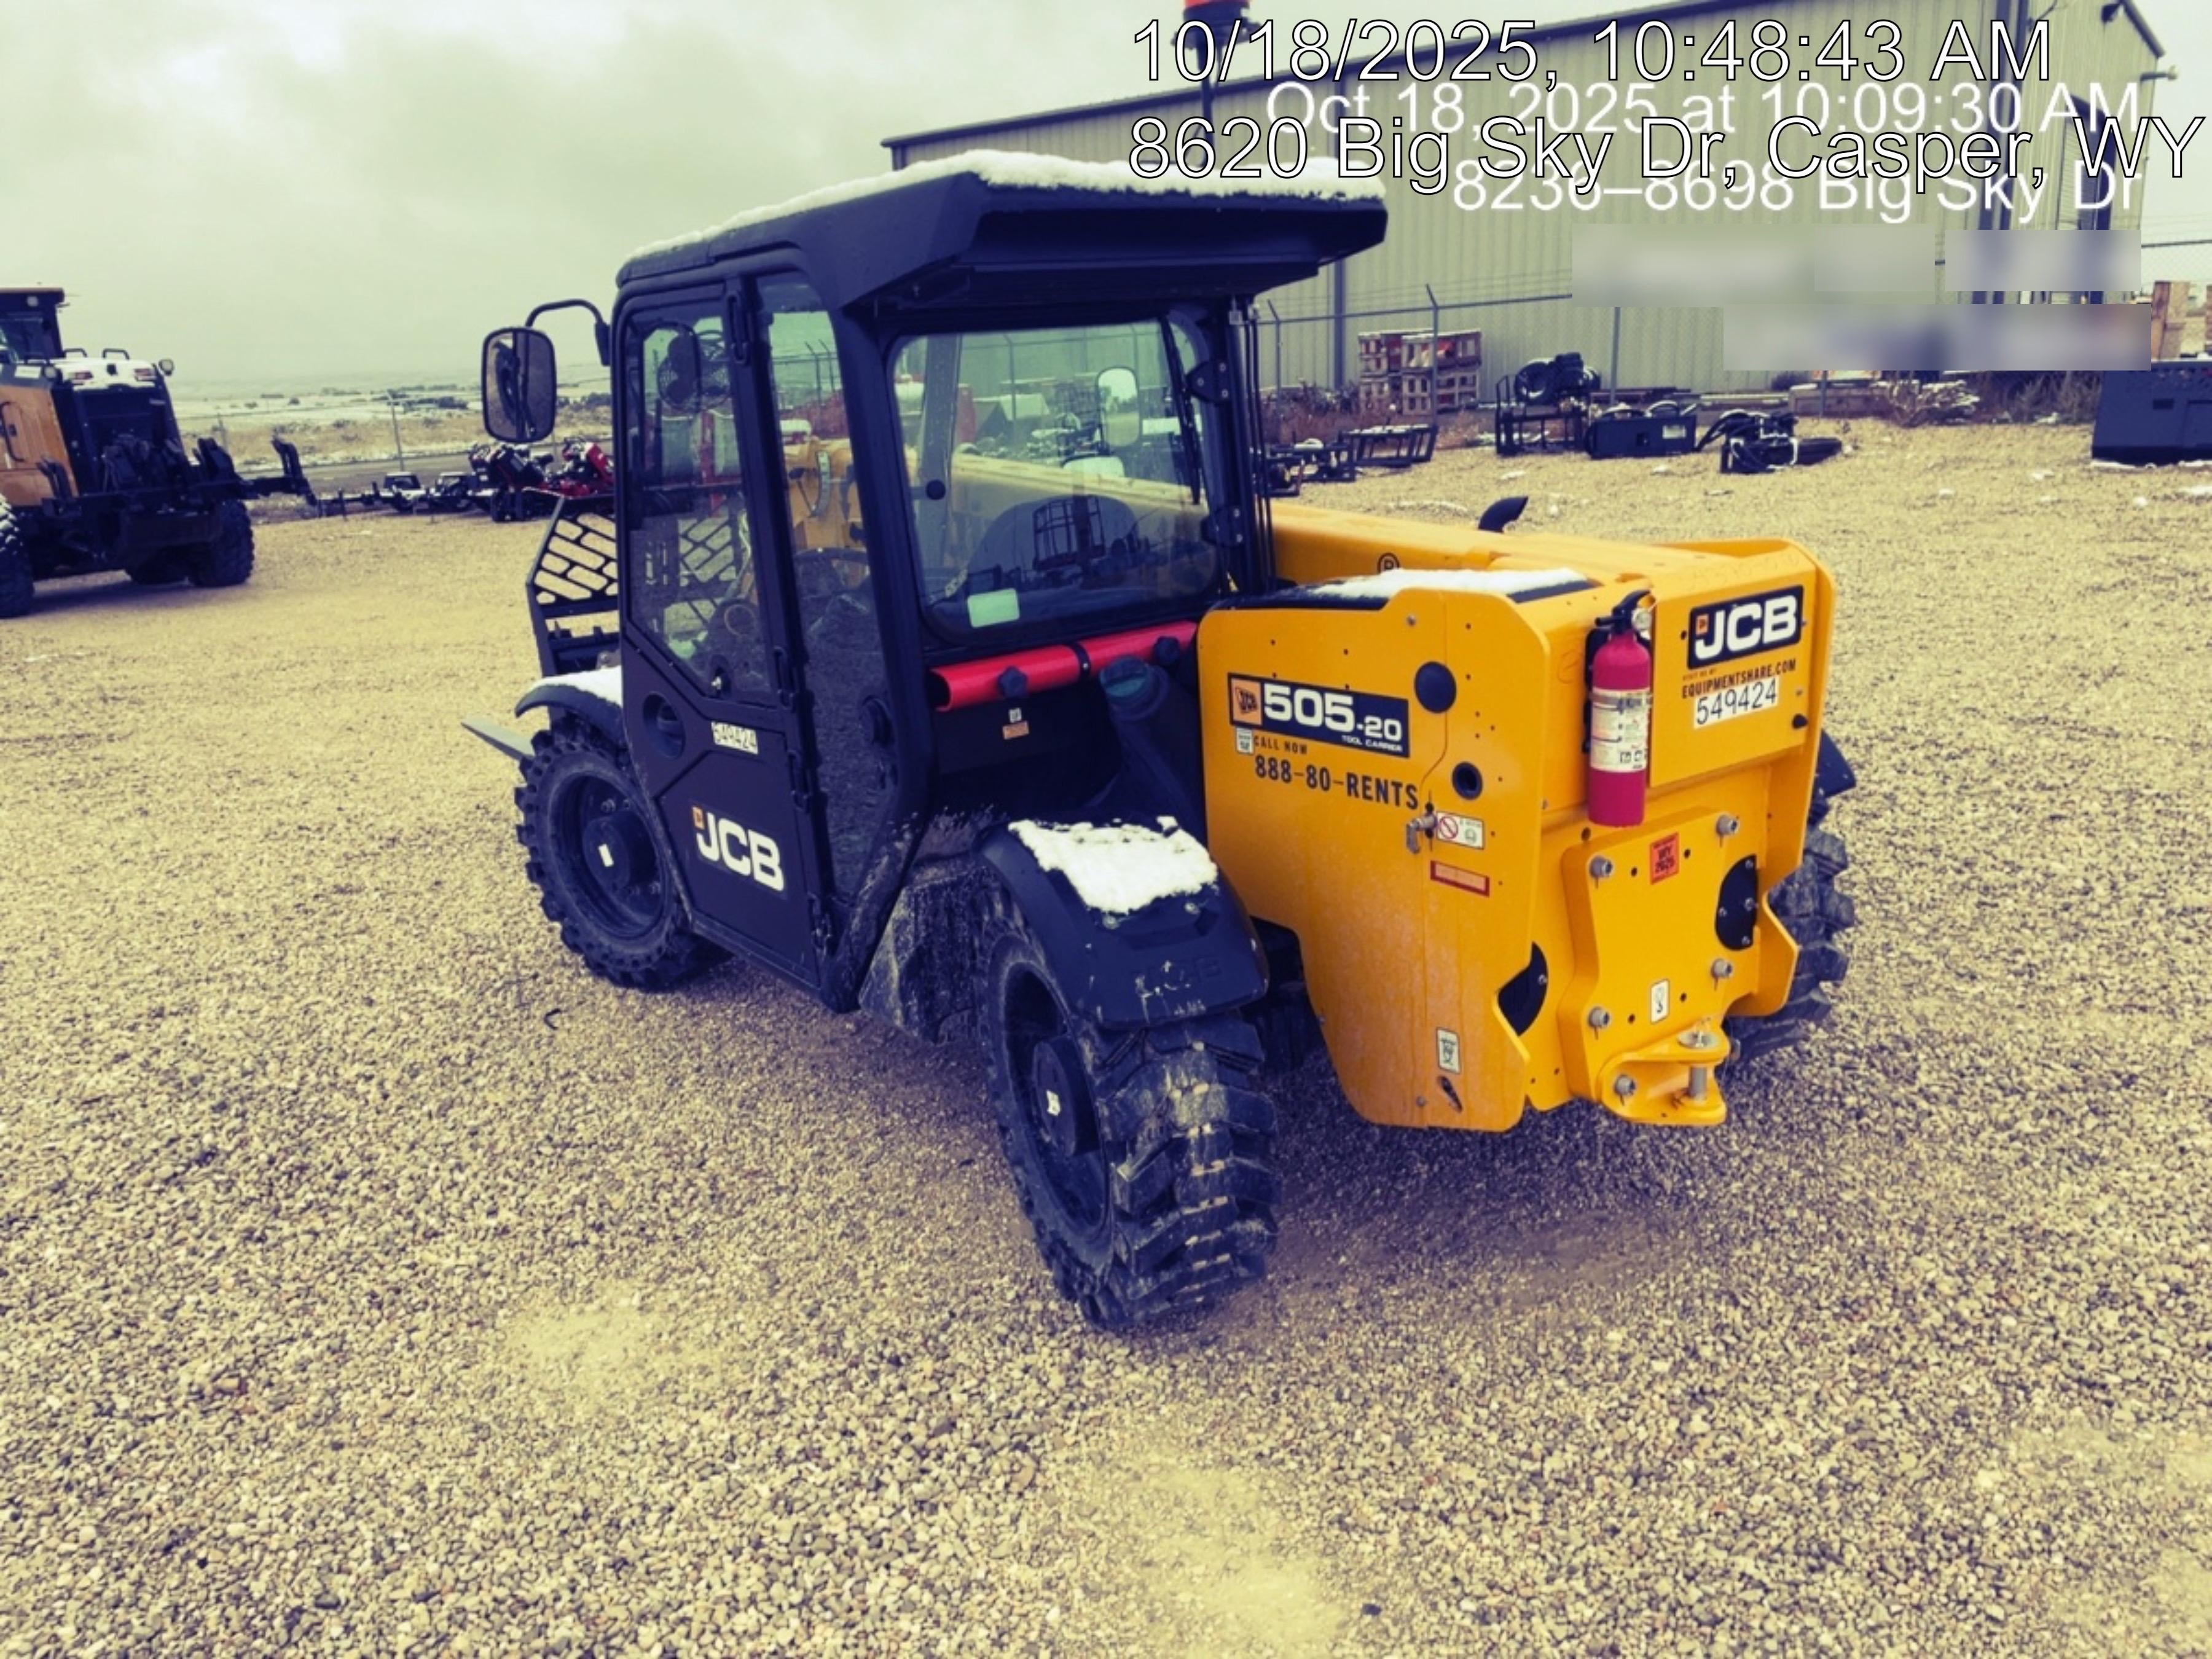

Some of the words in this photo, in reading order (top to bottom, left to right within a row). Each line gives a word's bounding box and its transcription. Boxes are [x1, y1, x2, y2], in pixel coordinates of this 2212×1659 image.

[1695, 595, 1797, 659] JCB
[1682, 658, 1796, 699] EQUIPMENTSHARE.COM
[1696, 678, 1776, 725] 549424
[1254, 735, 1279, 751] CALL
[1284, 740, 1308, 755] NOW
[1255, 754, 1418, 810] 888-80-RENTS
[696, 811, 784, 892] JCB
